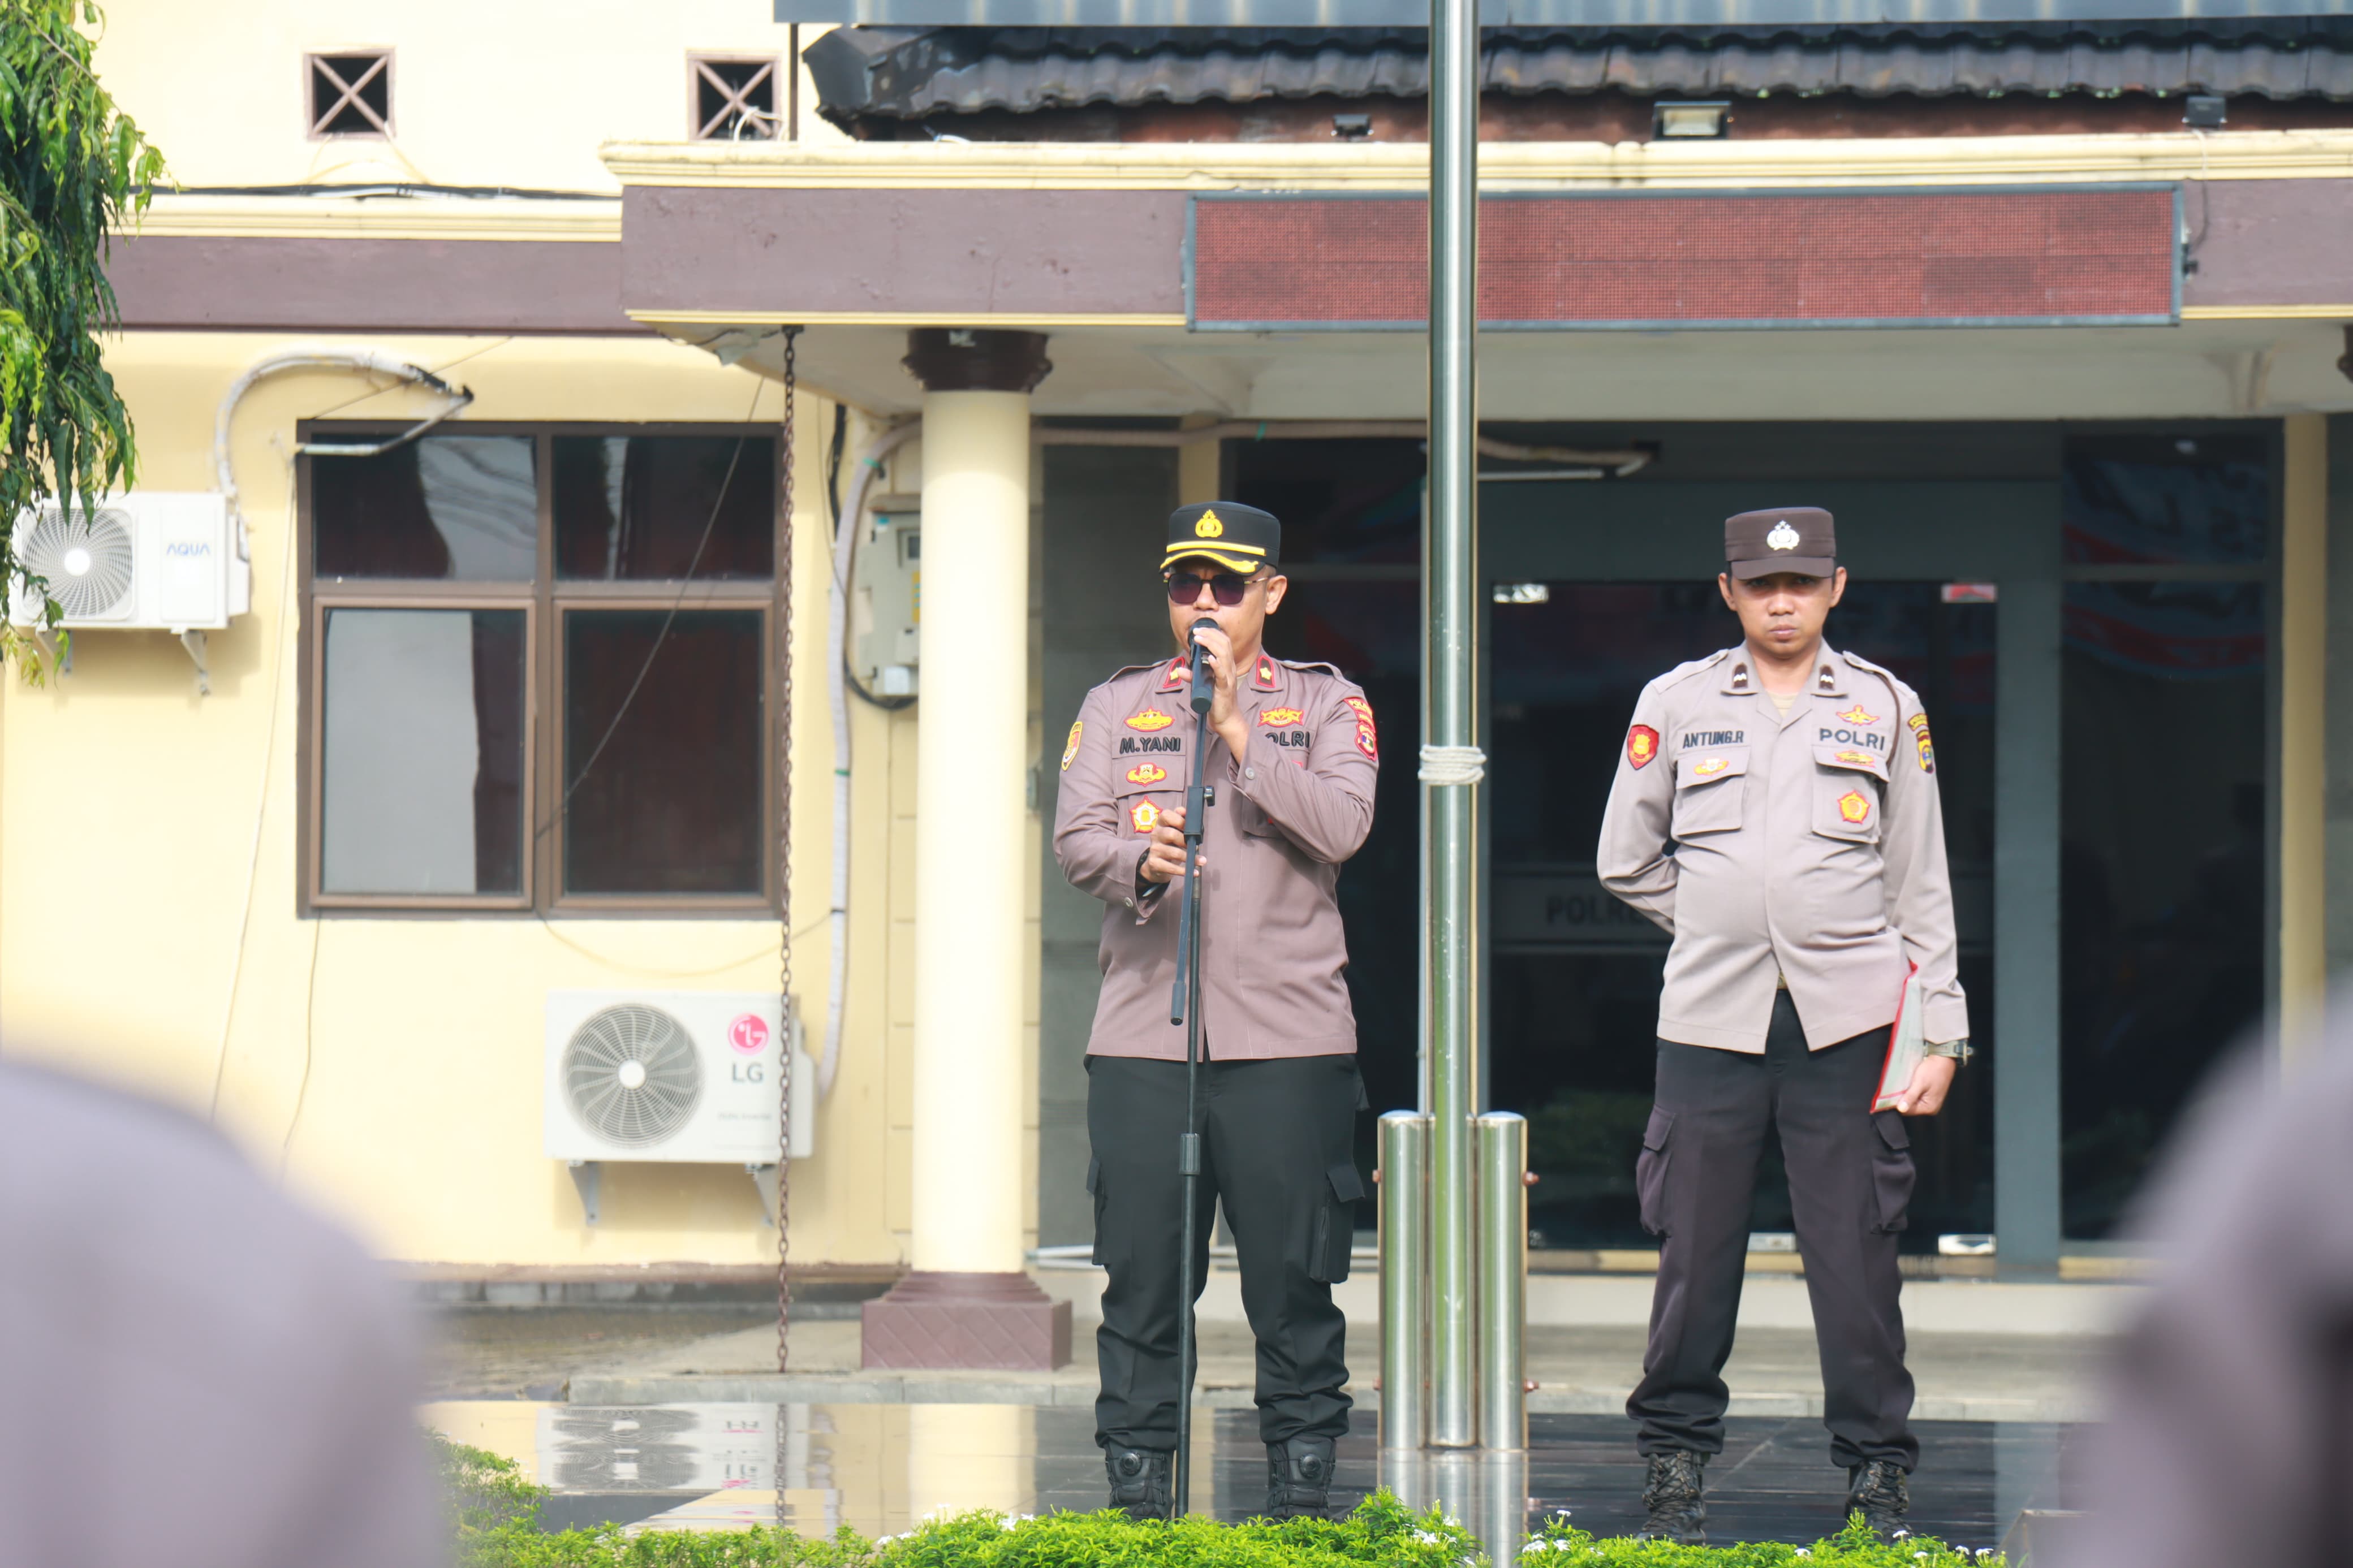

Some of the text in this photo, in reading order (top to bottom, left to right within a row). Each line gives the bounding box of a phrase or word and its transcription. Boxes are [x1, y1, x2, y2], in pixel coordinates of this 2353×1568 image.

[167, 543, 210, 556] AQUA
[1119, 737, 1180, 754] M.YANI
[1820, 728, 1885, 751] POLRI
[732, 1062, 764, 1083] LG
